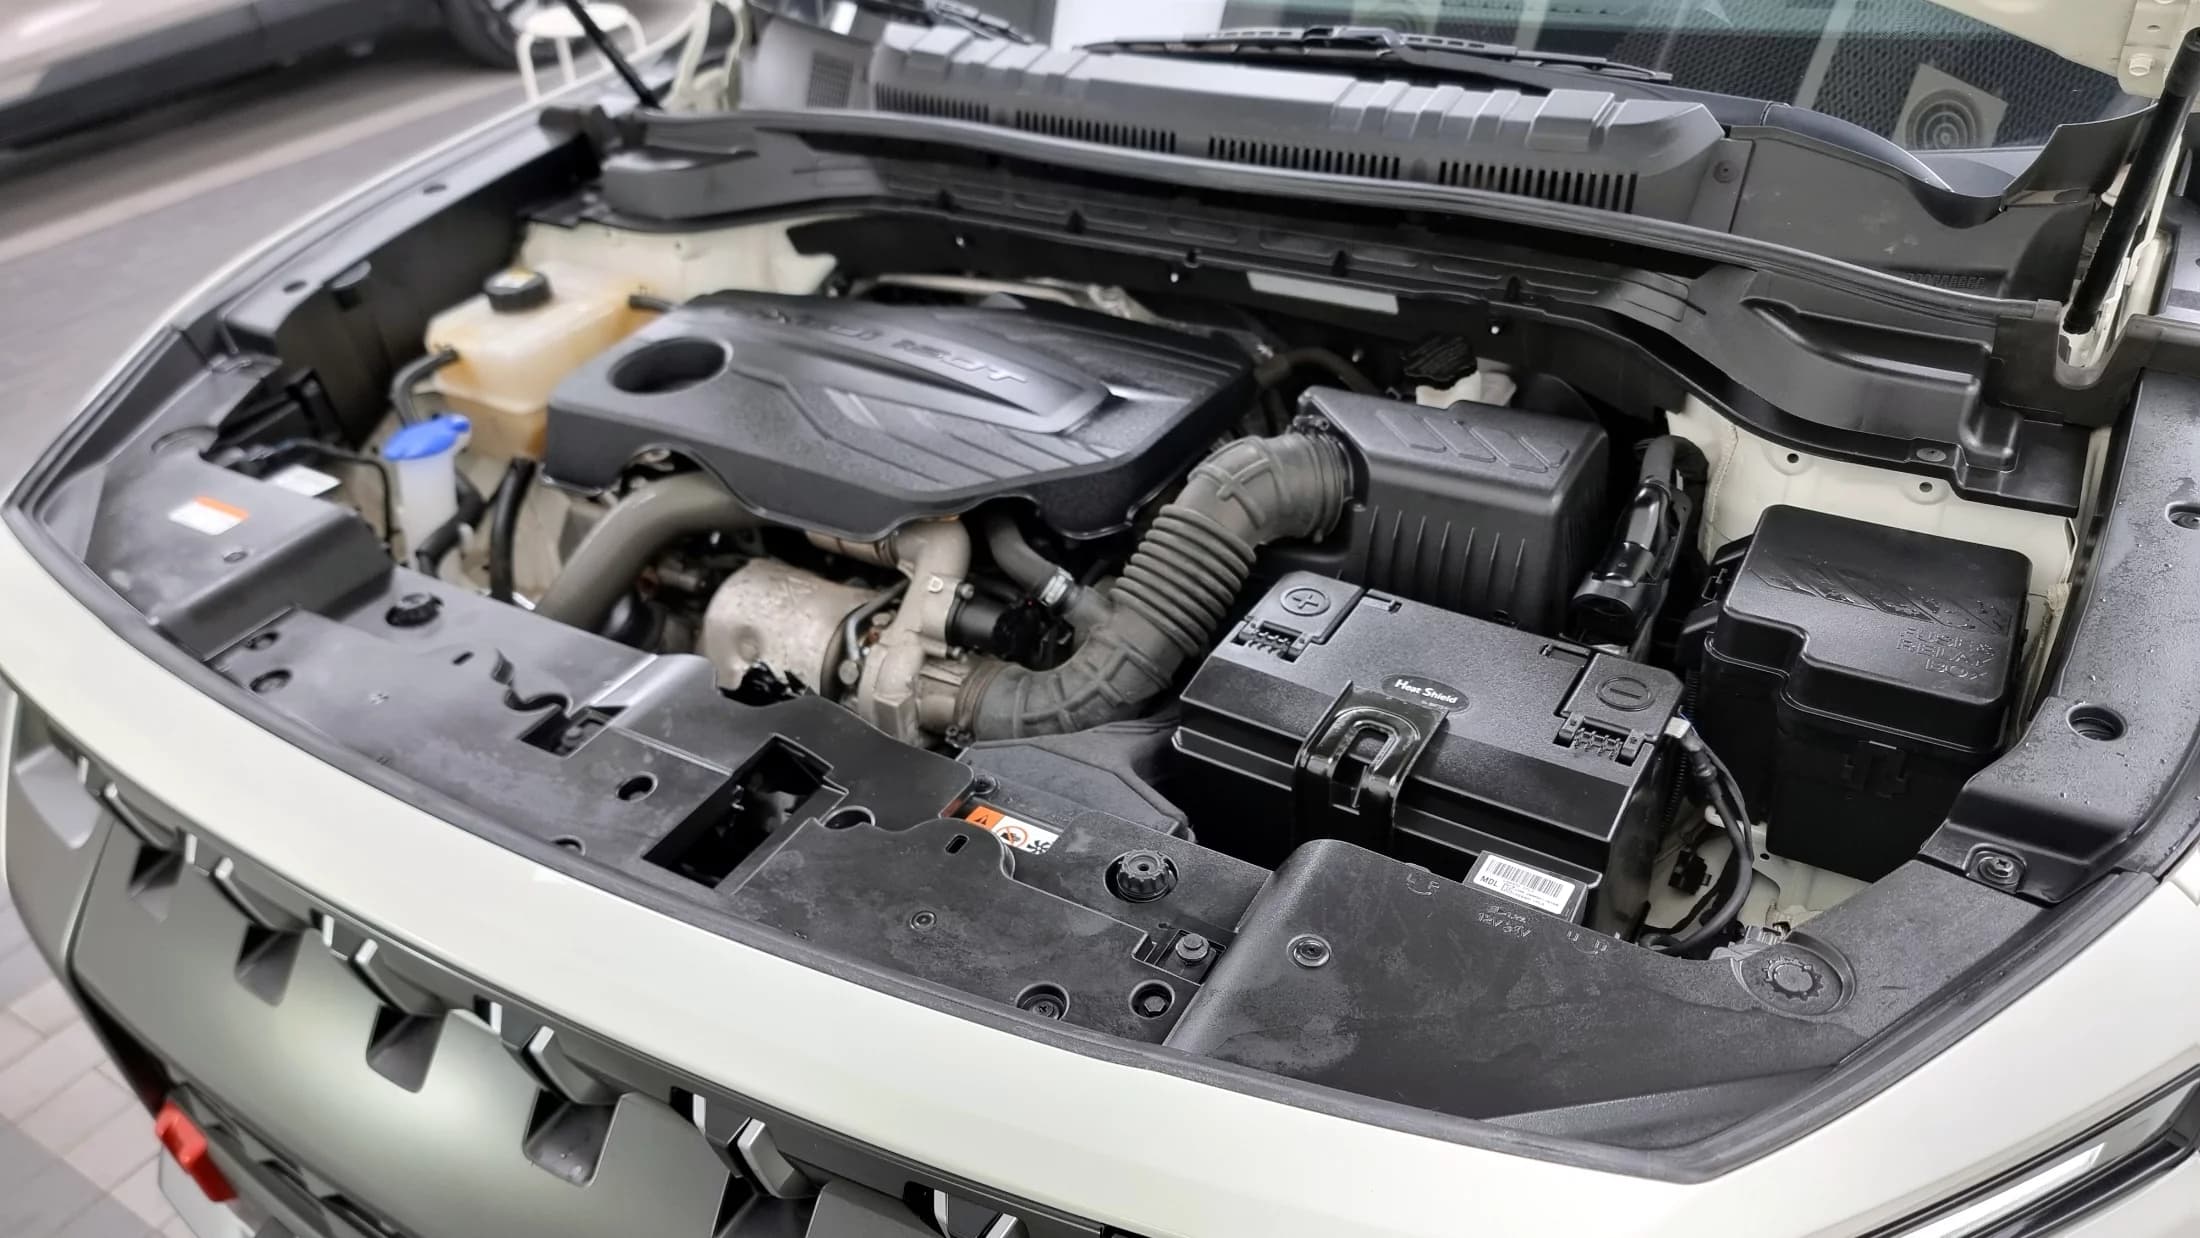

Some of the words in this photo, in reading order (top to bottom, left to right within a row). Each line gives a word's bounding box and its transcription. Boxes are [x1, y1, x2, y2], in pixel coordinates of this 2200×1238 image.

[1896, 640, 1993, 668] RELAY
[1925, 658, 1988, 680] BOX
[1394, 679, 1422, 694] Heat
[1422, 687, 1458, 704] Shield
[1480, 875, 1499, 888] MDL
